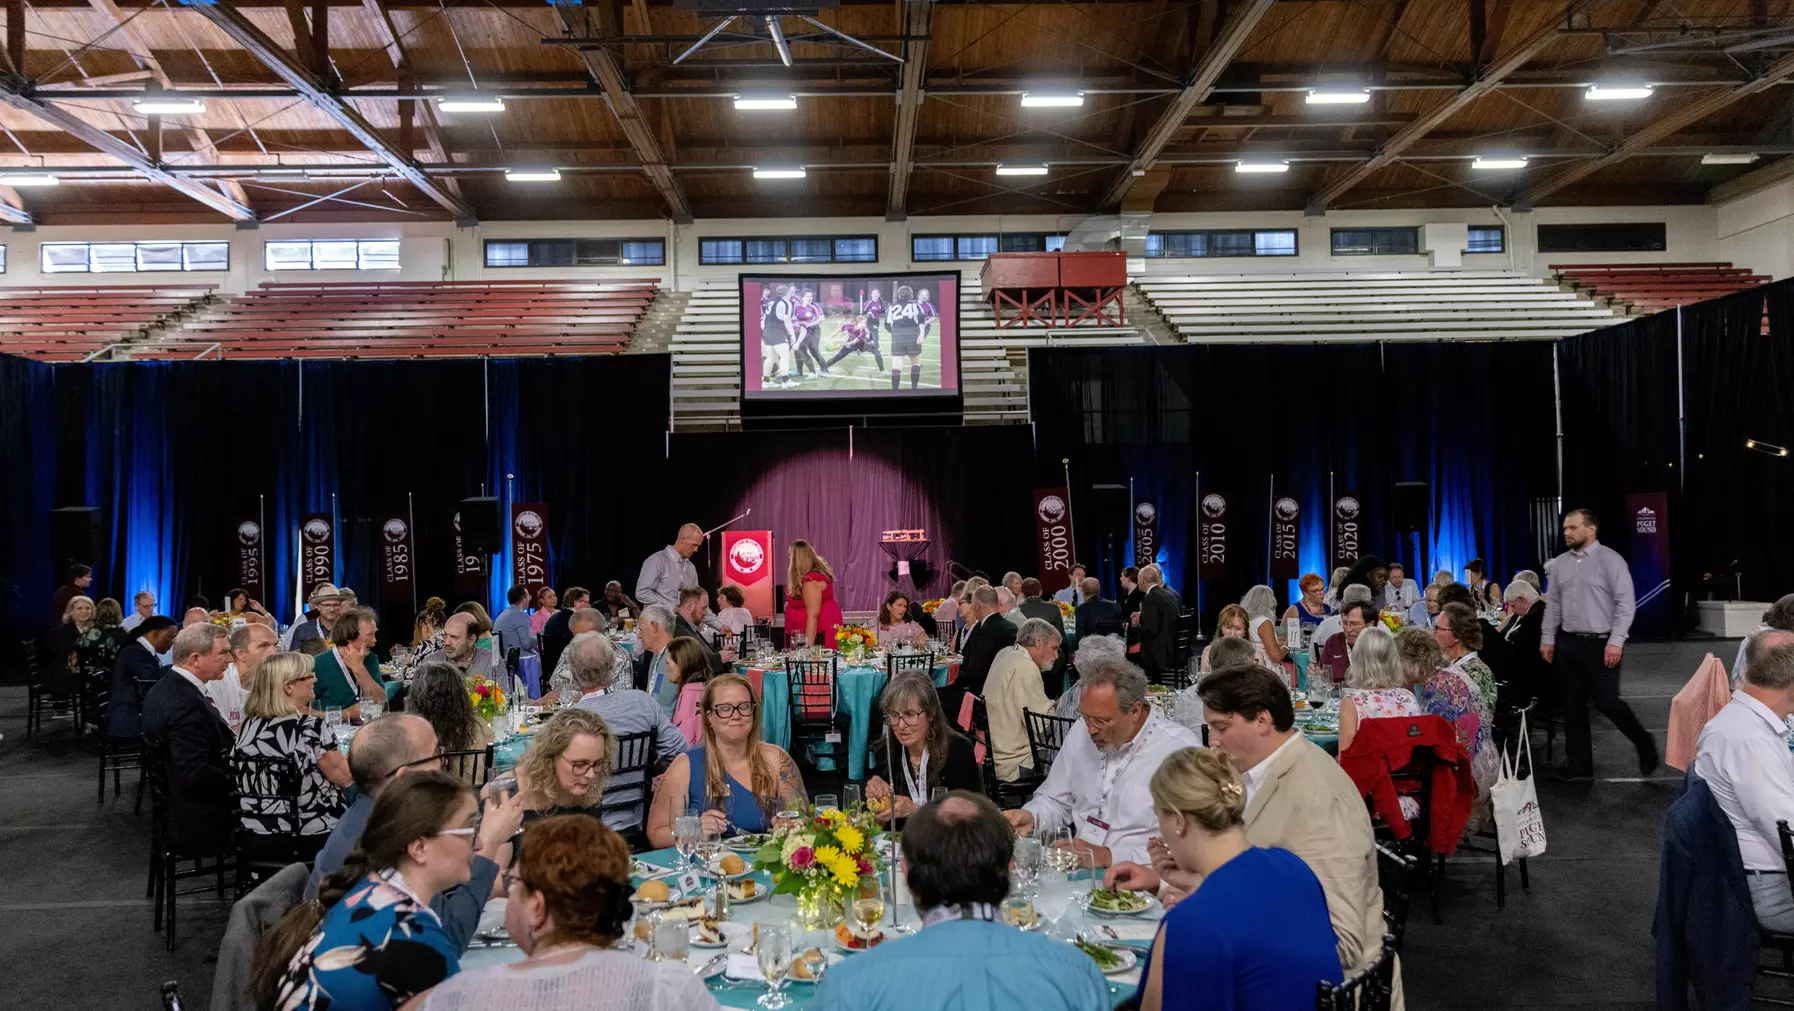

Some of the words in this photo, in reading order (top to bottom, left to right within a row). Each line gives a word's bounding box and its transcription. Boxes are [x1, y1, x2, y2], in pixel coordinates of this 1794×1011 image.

[1042, 527, 1051, 540] OF
[1202, 522, 1210, 535] OF
[1275, 521, 1283, 533] OF
[1338, 521, 1344, 533] OF
[240, 547, 248, 559] OF
[305, 545, 313, 557] OF
[384, 545, 392, 556] OF
[517, 541, 525, 554] OF
[1050, 525, 1069, 571] 2000
[1141, 528, 1153, 565] 2005
[1201, 535, 1209, 564] CLASS
[1210, 523, 1226, 563] 2010
[1275, 534, 1283, 559] CLASS
[1282, 523, 1296, 560] 2015
[1337, 534, 1346, 559] CLASS
[1344, 521, 1359, 560] 2020
[248, 547, 259, 585] 1995
[314, 545, 330, 583] 1990
[393, 544, 408, 582] 1985
[456, 548, 465, 574] CLASS
[464, 555, 480, 573] 19
[526, 542, 544, 585] 1975
[1043, 540, 1053, 571] CLASS
[305, 560, 313, 584] CLASS
[386, 556, 394, 583] CLASS
